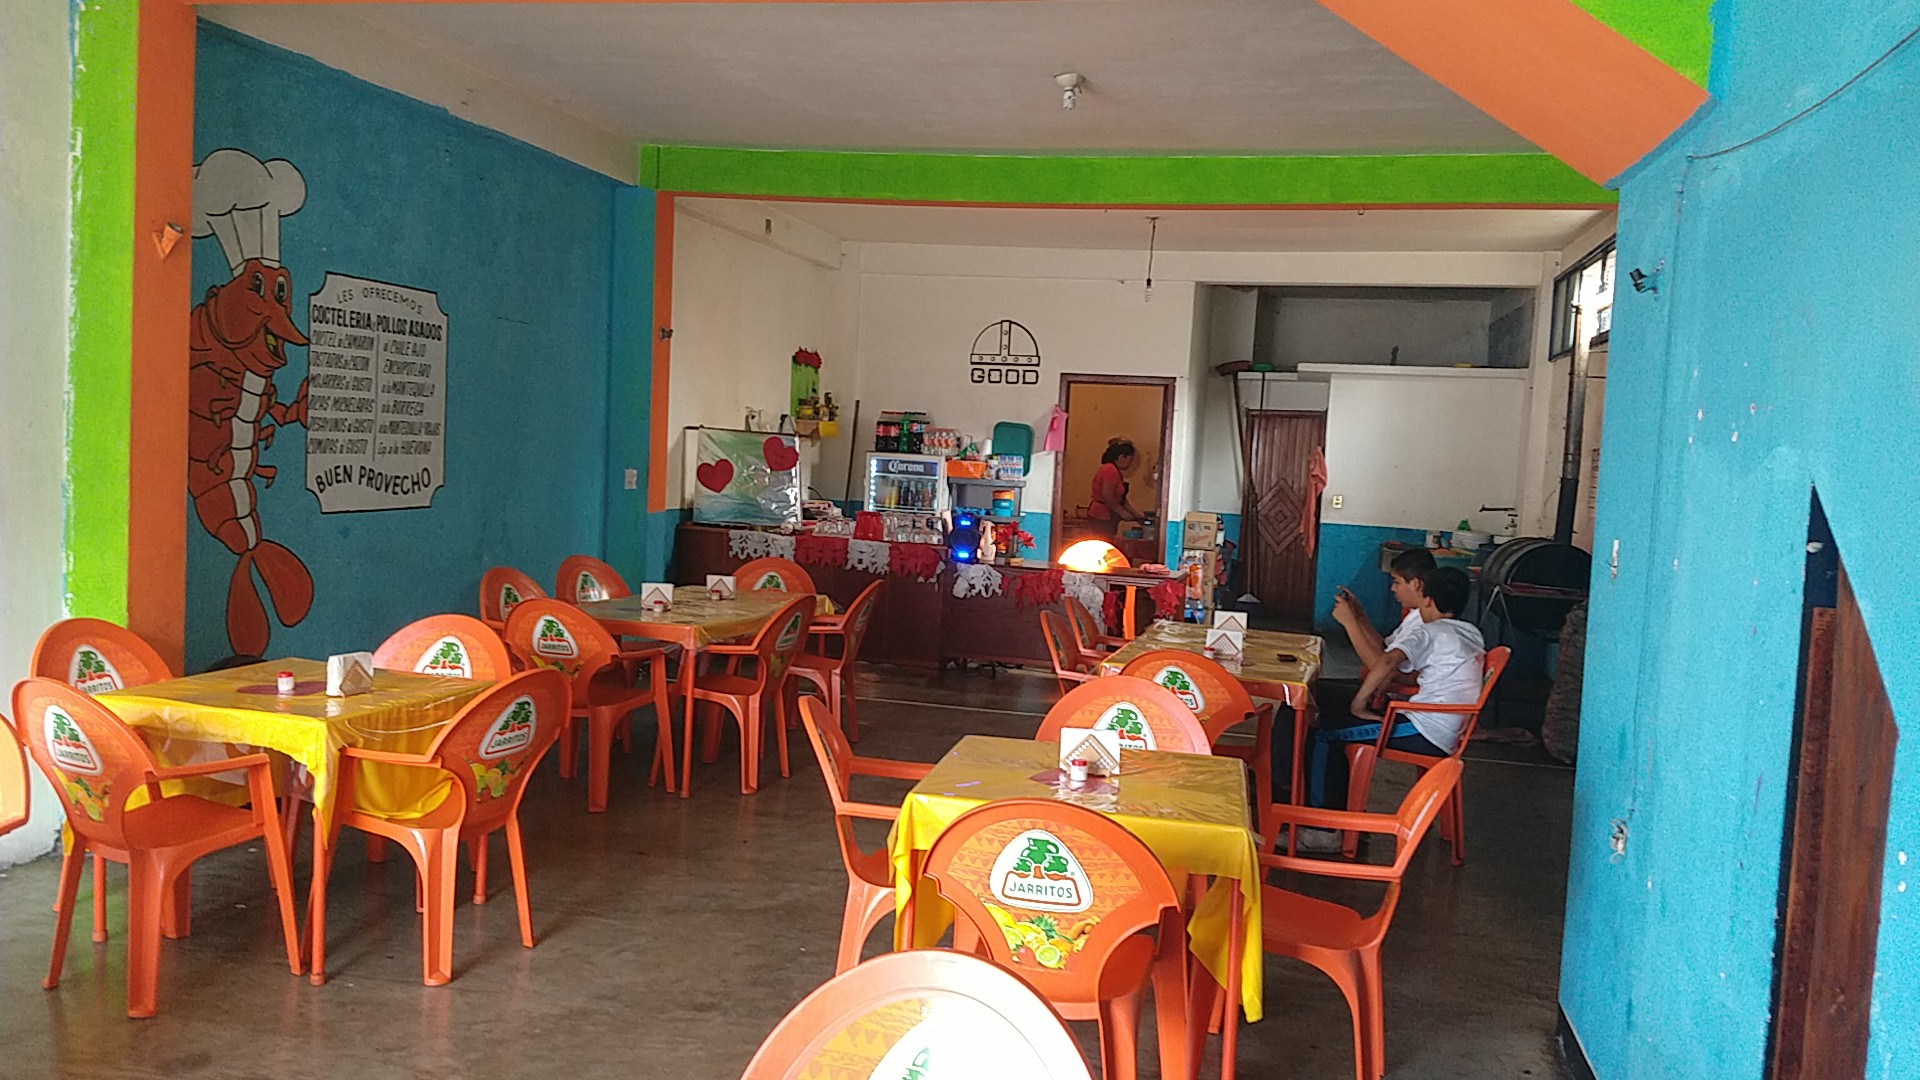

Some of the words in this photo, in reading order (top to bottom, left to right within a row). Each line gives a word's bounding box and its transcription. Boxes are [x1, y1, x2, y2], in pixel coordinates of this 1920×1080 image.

[337, 289, 354, 304] LES
[361, 287, 423, 315] OFRECEMOS
[312, 304, 372, 333] COCTELERIA
[376, 314, 408, 336] POLLOS
[408, 319, 443, 341] ASADOS
[389, 339, 411, 356] CHILE
[971, 368, 1039, 385] GOOD
[888, 459, 924, 474] Corona
[315, 464, 353, 494] BUEN
[358, 465, 431, 495] PROVECHO
[1009, 881, 1073, 899] JARRITOS
